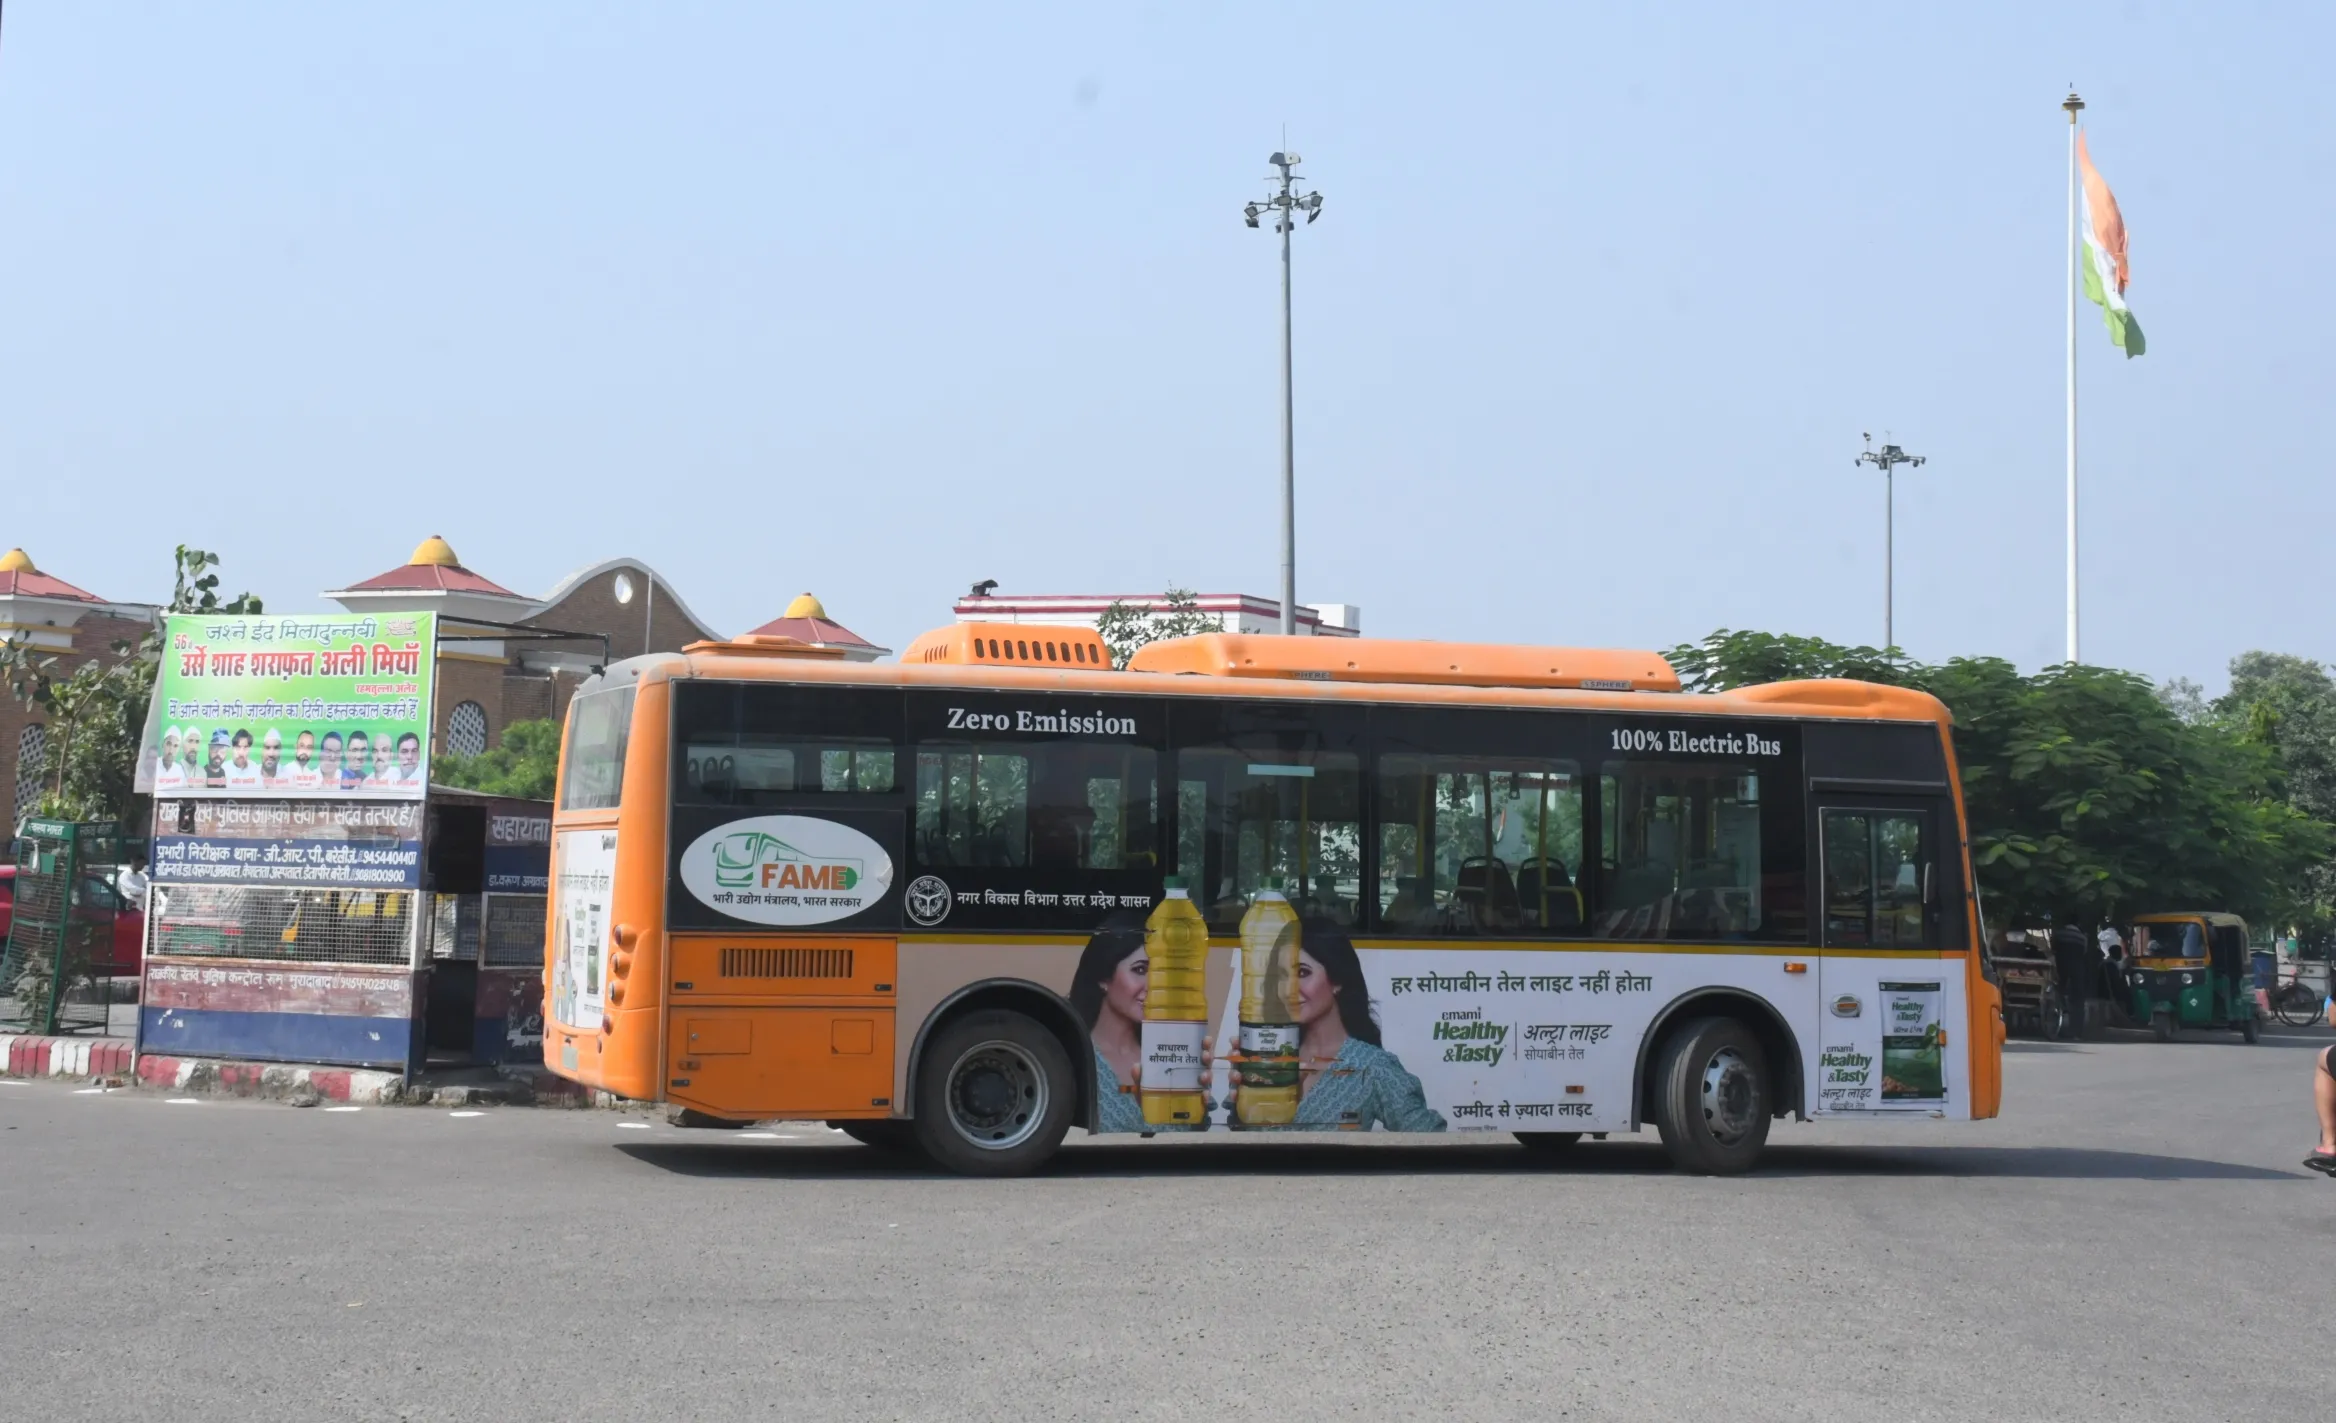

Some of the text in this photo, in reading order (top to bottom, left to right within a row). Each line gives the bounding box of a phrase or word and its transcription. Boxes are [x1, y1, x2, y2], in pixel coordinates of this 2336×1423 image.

[251, 619, 275, 642] ईद
[174, 634, 187, 649] 56
[212, 653, 247, 676] शाह
[320, 644, 366, 675] अली
[202, 699, 219, 718] वाले
[286, 704, 299, 718] का
[947, 708, 1137, 735] Zero Emission
[1611, 729, 1781, 756] 100% Electric Bus
[492, 815, 550, 841] सहायता
[156, 842, 185, 860] प्रभारी
[762, 863, 847, 891] FAME
[713, 892, 733, 904] भारी
[736, 892, 761, 905] उद्योग
[803, 896, 827, 907] भारत
[829, 898, 862, 908] सरकार
[957, 889, 1150, 909] नगर विकास विभाग उत्तर प्रदेश शासन
[1391, 970, 1653, 996] हर सोयाबीन तेल लाइट नहीं होता
[1441, 1006, 1481, 1021] emami
[1892, 1001, 1924, 1013] Healthy
[1433, 1021, 1509, 1045] Healthy
[1524, 1024, 1612, 1045] अल्ट्रा लाइट
[1157, 1043, 1189, 1053] साधारण
[1443, 1043, 1504, 1068] &Tasty
[1524, 1045, 1585, 1062] सोयाबीन तेल
[1149, 1052, 1199, 1064] सोयाबीन तेल
[1820, 1053, 1873, 1070] Healthy
[1828, 1069, 1870, 1086] &Tasty
[1848, 1088, 1873, 1100] लाइट
[1453, 1100, 1593, 1120] उम्मीद से ज़्यादा लाइट
